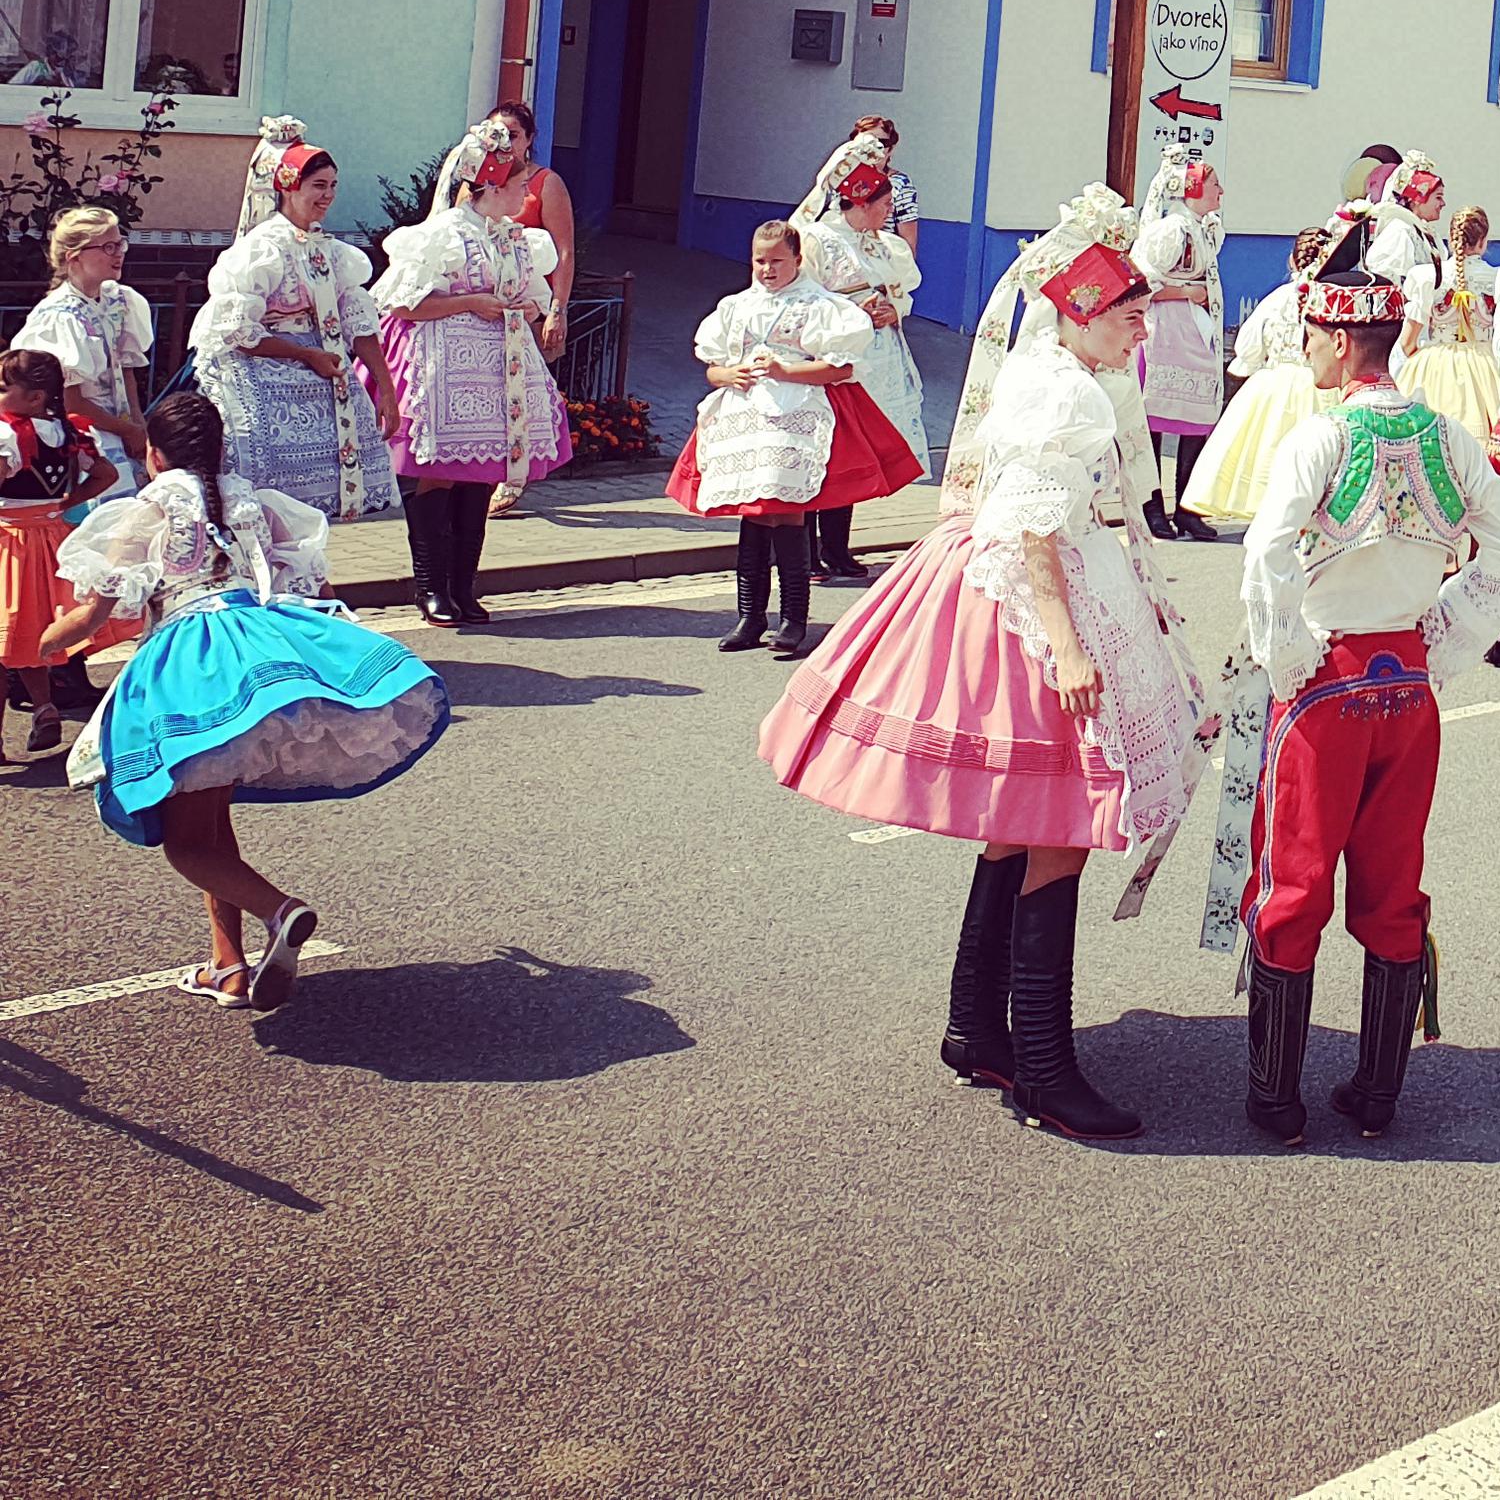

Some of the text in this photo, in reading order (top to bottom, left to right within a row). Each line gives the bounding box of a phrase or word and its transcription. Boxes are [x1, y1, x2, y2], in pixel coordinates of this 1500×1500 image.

[1157, 3, 1223, 28] Dvorek
[1159, 32, 1218, 54] jako víno
